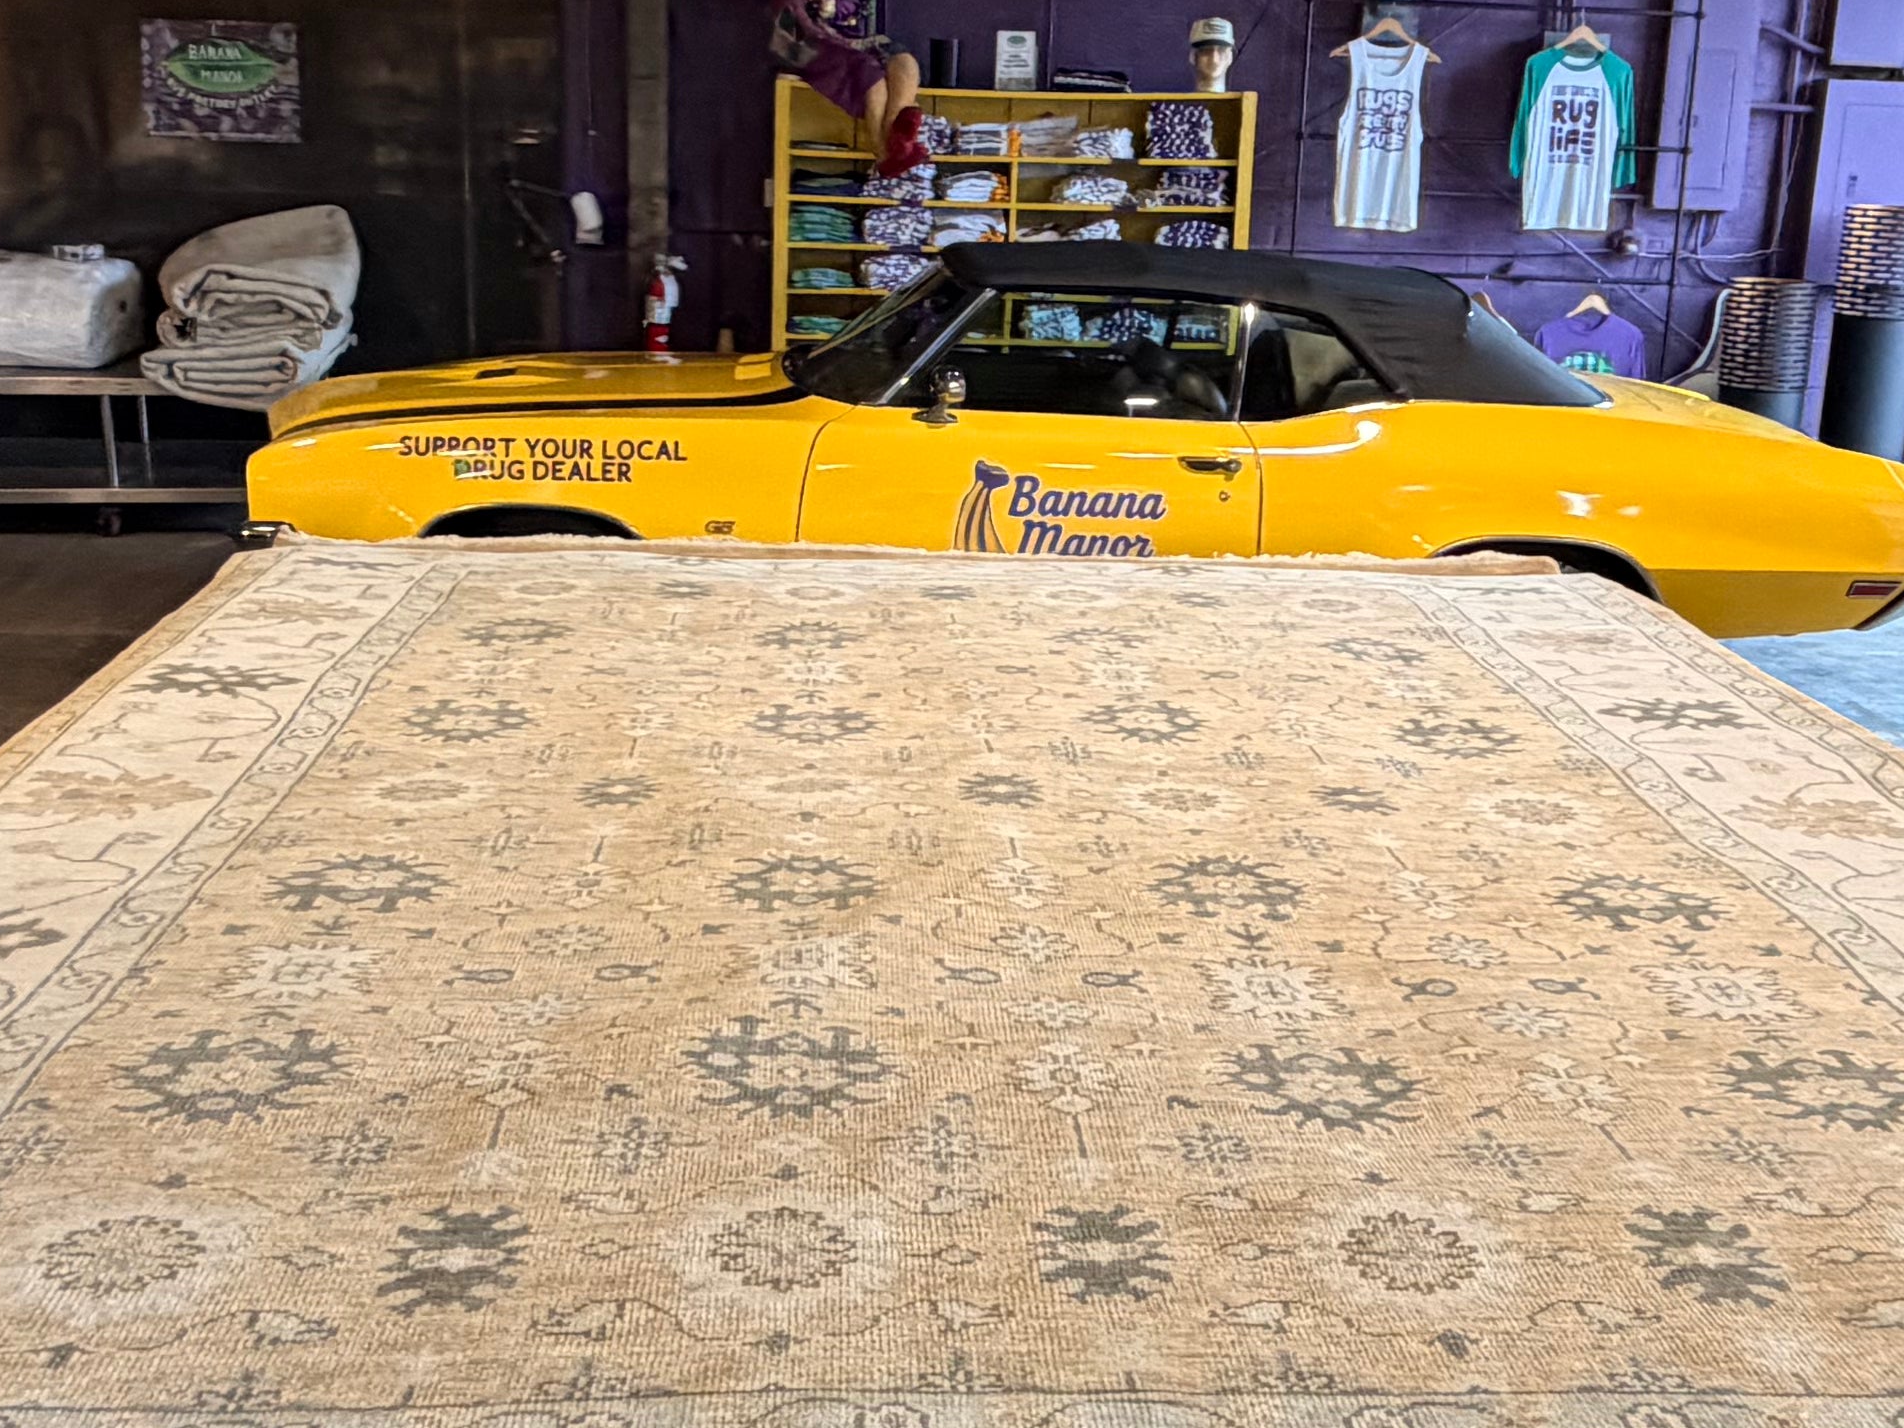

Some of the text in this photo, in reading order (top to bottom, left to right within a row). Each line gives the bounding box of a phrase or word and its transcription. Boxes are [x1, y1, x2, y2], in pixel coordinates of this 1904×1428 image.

[188, 43, 243, 60] BANANA
[398, 435, 688, 462] SUPPORT YOUR LOCAL
[452, 458, 632, 483] DRUG DEALER
[1008, 474, 1167, 520] Banana
[1018, 518, 1155, 557] Manor
